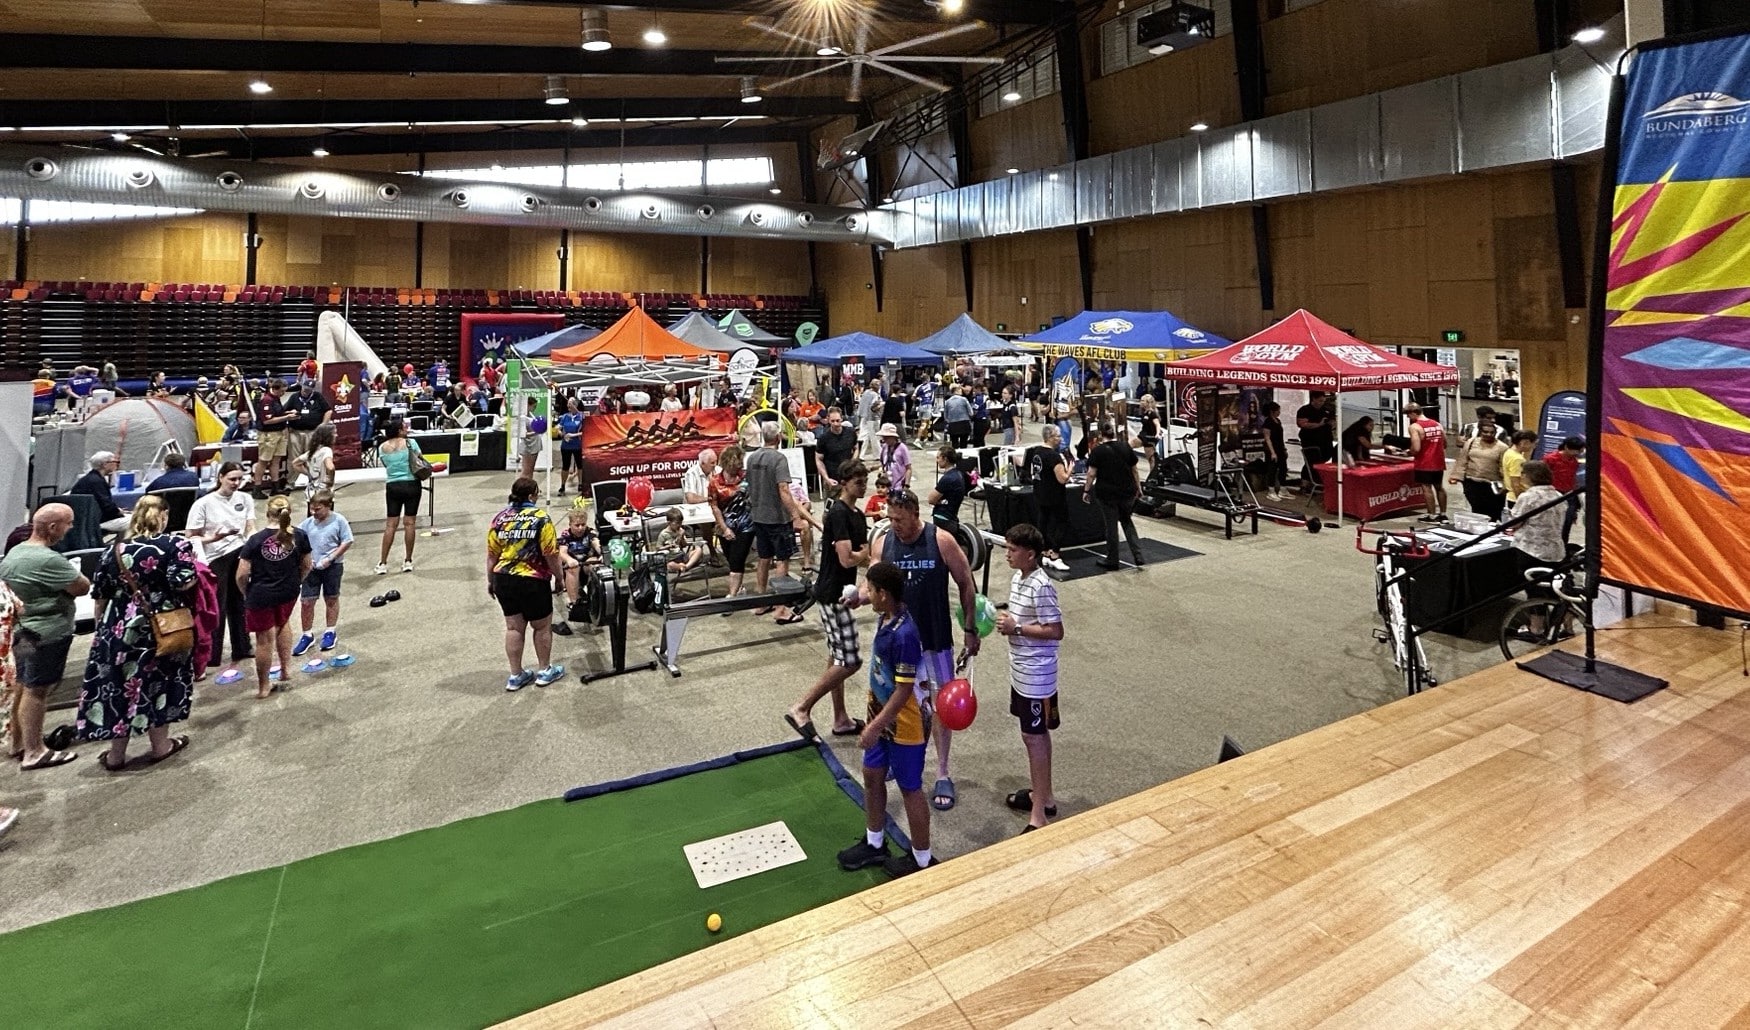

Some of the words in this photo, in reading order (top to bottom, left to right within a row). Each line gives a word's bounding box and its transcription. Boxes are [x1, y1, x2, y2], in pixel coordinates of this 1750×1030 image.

[1646, 112, 1748, 133] BUNDABERG
[1043, 345, 1056, 356] THE
[1058, 346, 1085, 356] WAVES
[1087, 348, 1102, 358] AFL
[1104, 350, 1126, 360] CLUB
[1243, 344, 1307, 353] WORLD
[842, 363, 864, 375] MMB
[1167, 367, 1214, 377] BUILDING
[1217, 370, 1267, 381] LEGENDS
[1271, 374, 1307, 383] SINCE
[1309, 376, 1337, 386] 1976
[1341, 376, 1382, 386] BUILDING
[1383, 374, 1419, 384] LEGENDS
[609, 465, 634, 475] SIGN
[636, 464, 650, 472] UP
[652, 462, 672, 471] FOR
[1369, 491, 1400, 507] WORLD
[498, 529, 537, 539] McCULKIN
